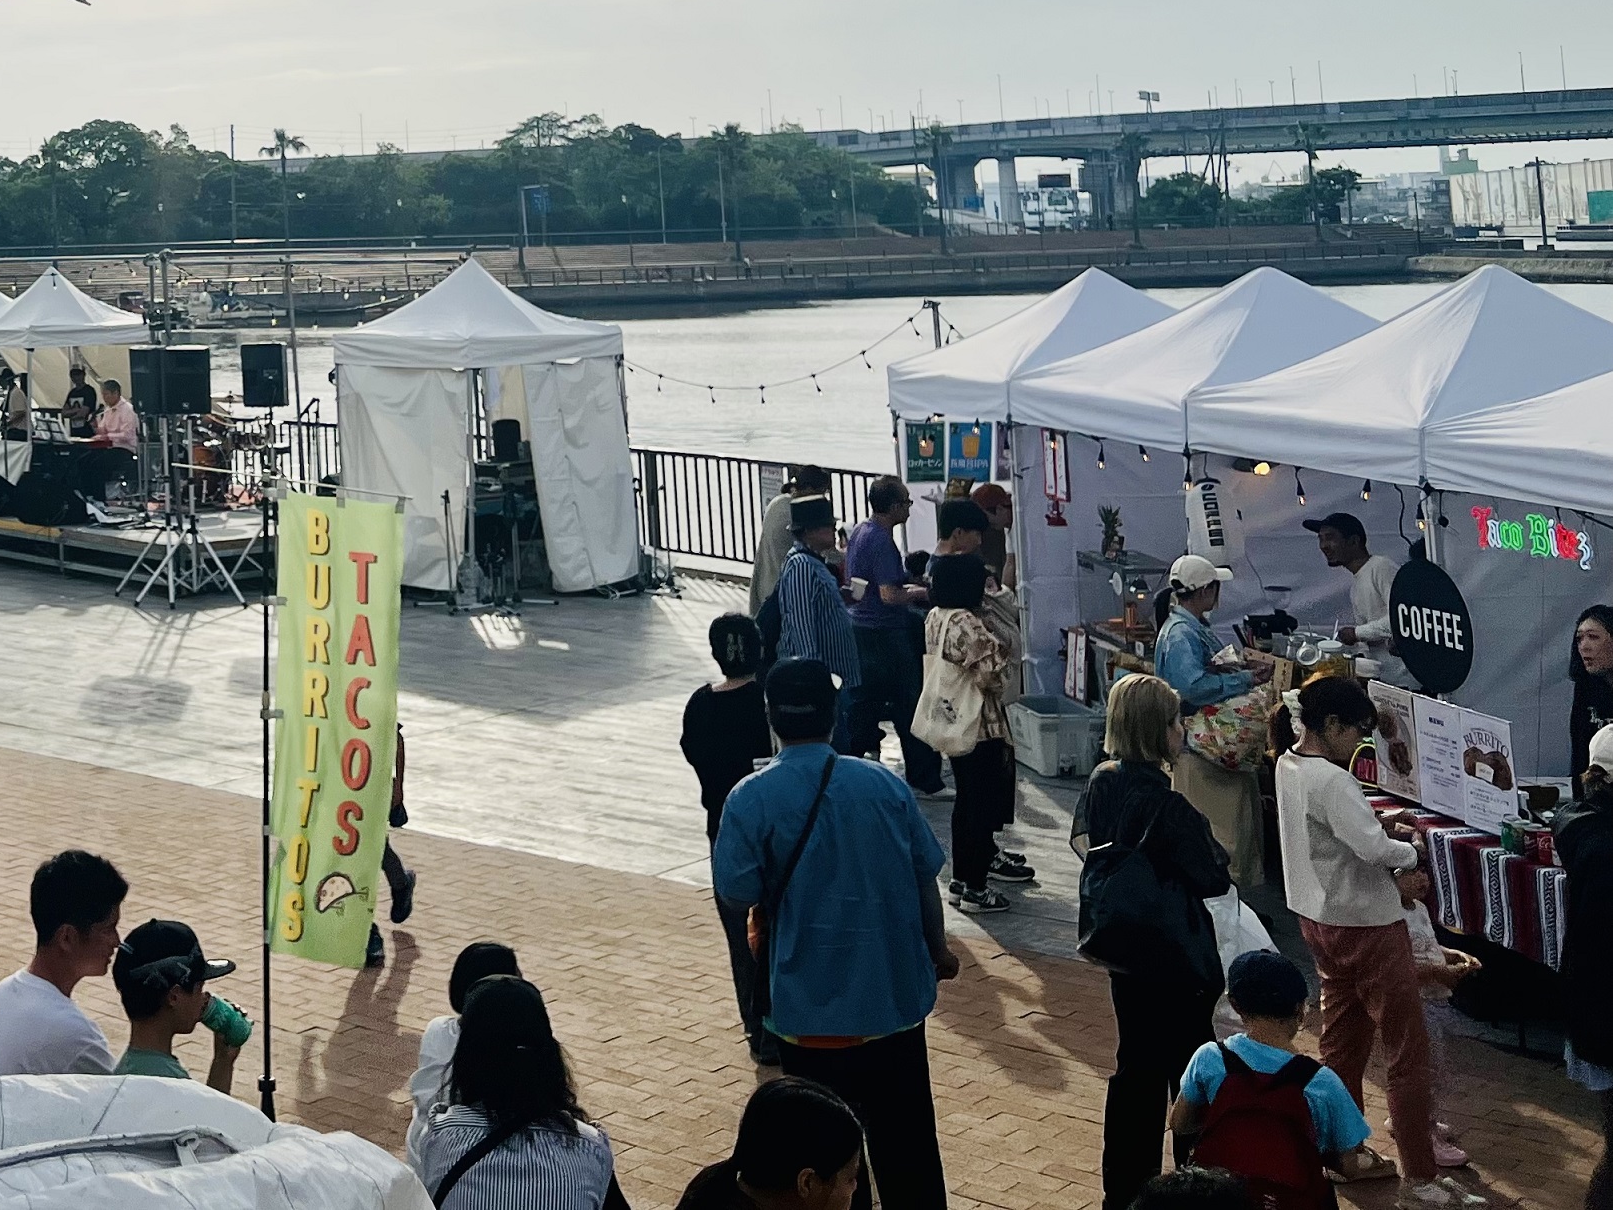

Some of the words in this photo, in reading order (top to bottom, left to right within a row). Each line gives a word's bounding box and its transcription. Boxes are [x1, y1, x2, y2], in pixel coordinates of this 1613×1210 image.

[1471, 506, 1524, 551] Taco
[1397, 602, 1464, 652] COFFEE
[280, 507, 331, 942] BURRITOS
[331, 550, 377, 856] TACOS
[1463, 730, 1510, 759] BURRITO
